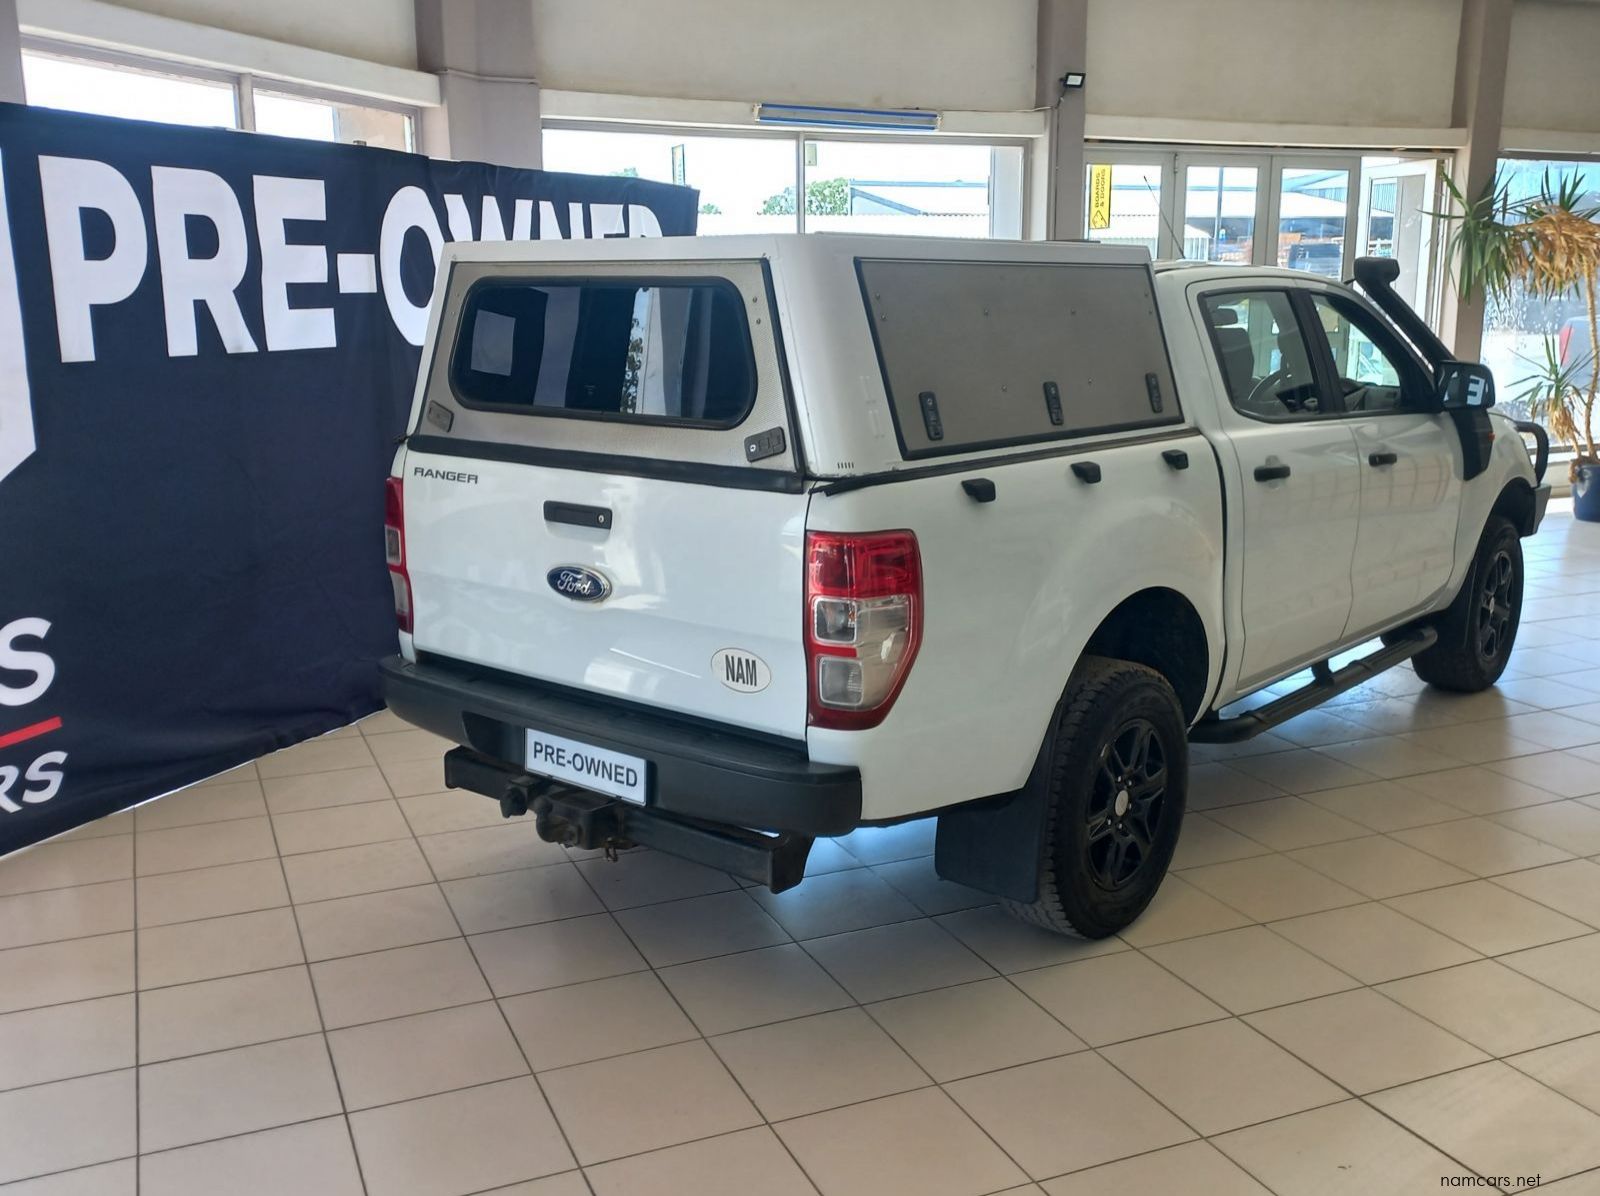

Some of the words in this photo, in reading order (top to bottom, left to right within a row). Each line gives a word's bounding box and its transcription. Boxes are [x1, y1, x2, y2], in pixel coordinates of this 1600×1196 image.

[414, 467, 478, 484] RANGER
[557, 570, 592, 595] Ford
[725, 654, 757, 687] NAM
[533, 741, 638, 787] PRE-OWNED
